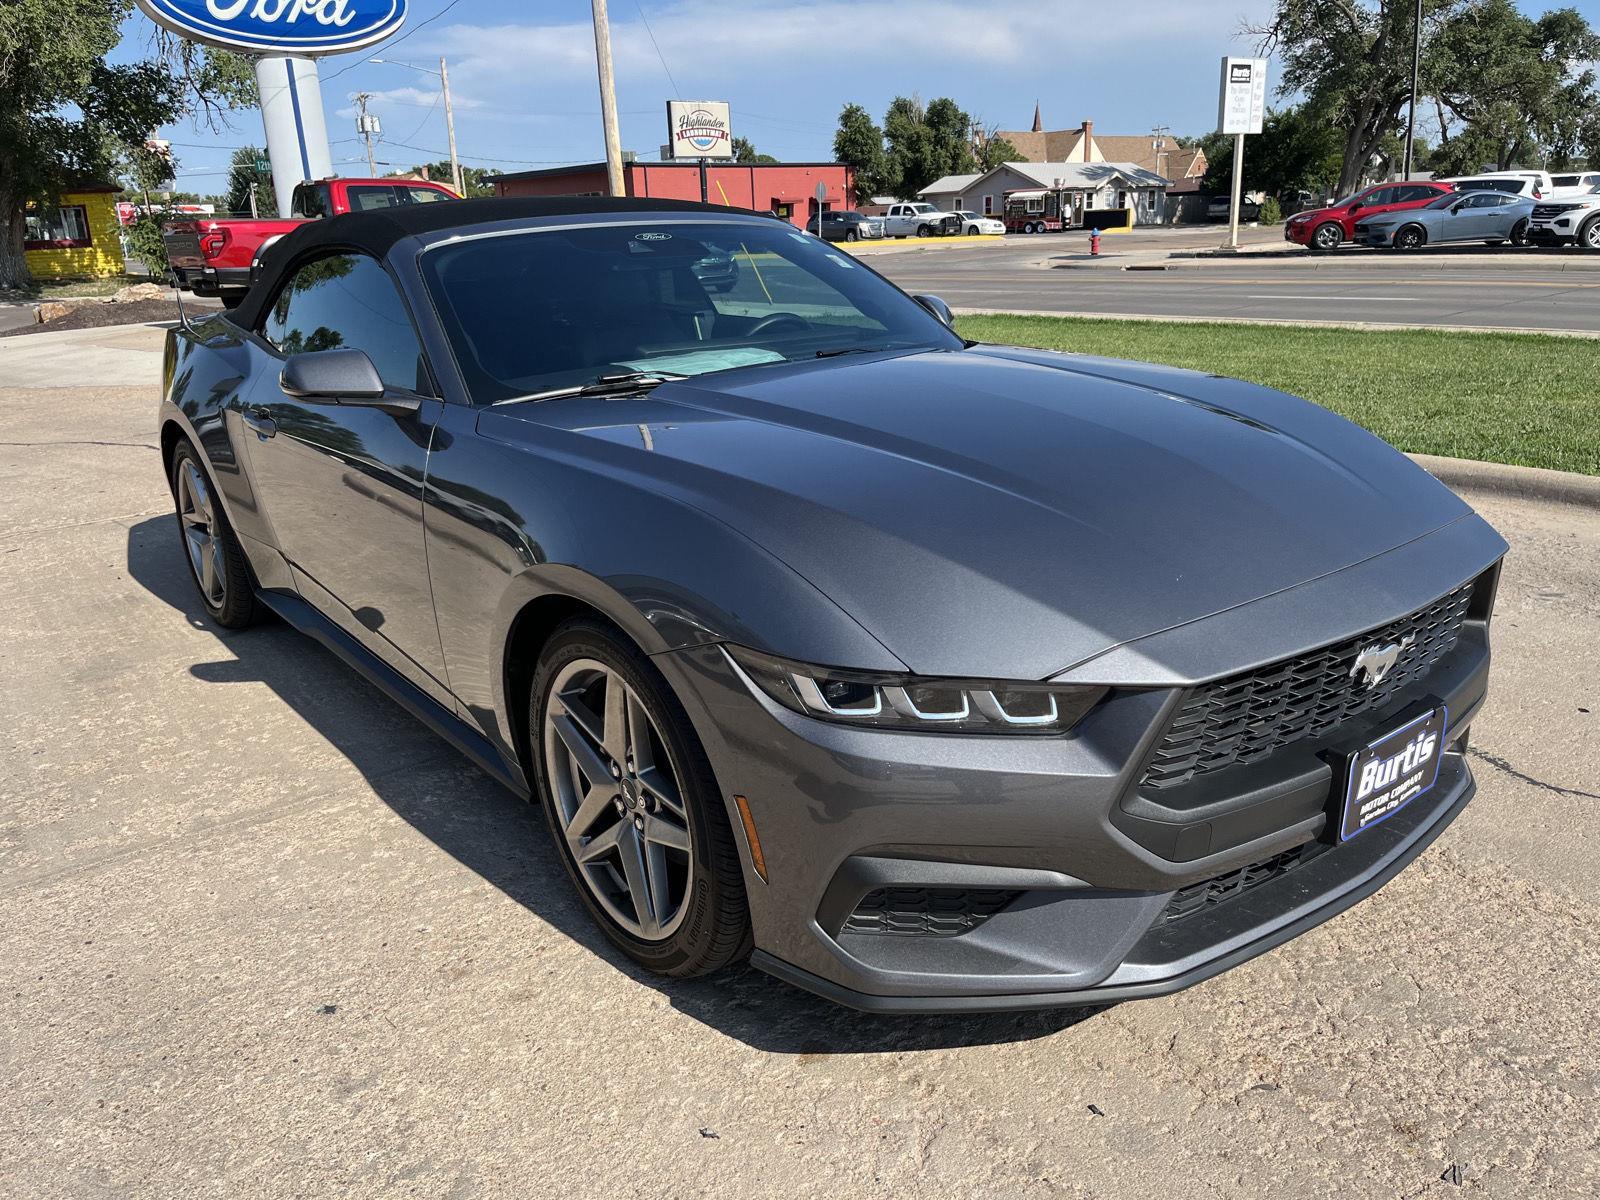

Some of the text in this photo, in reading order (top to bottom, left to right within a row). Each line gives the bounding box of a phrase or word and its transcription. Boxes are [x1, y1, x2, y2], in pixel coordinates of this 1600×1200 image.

[679, 115, 725, 129] Highlander
[642, 232, 666, 240] Ford
[1356, 733, 1436, 800] Burtis
[1360, 770, 1425, 816] MOTOR COMPANY
